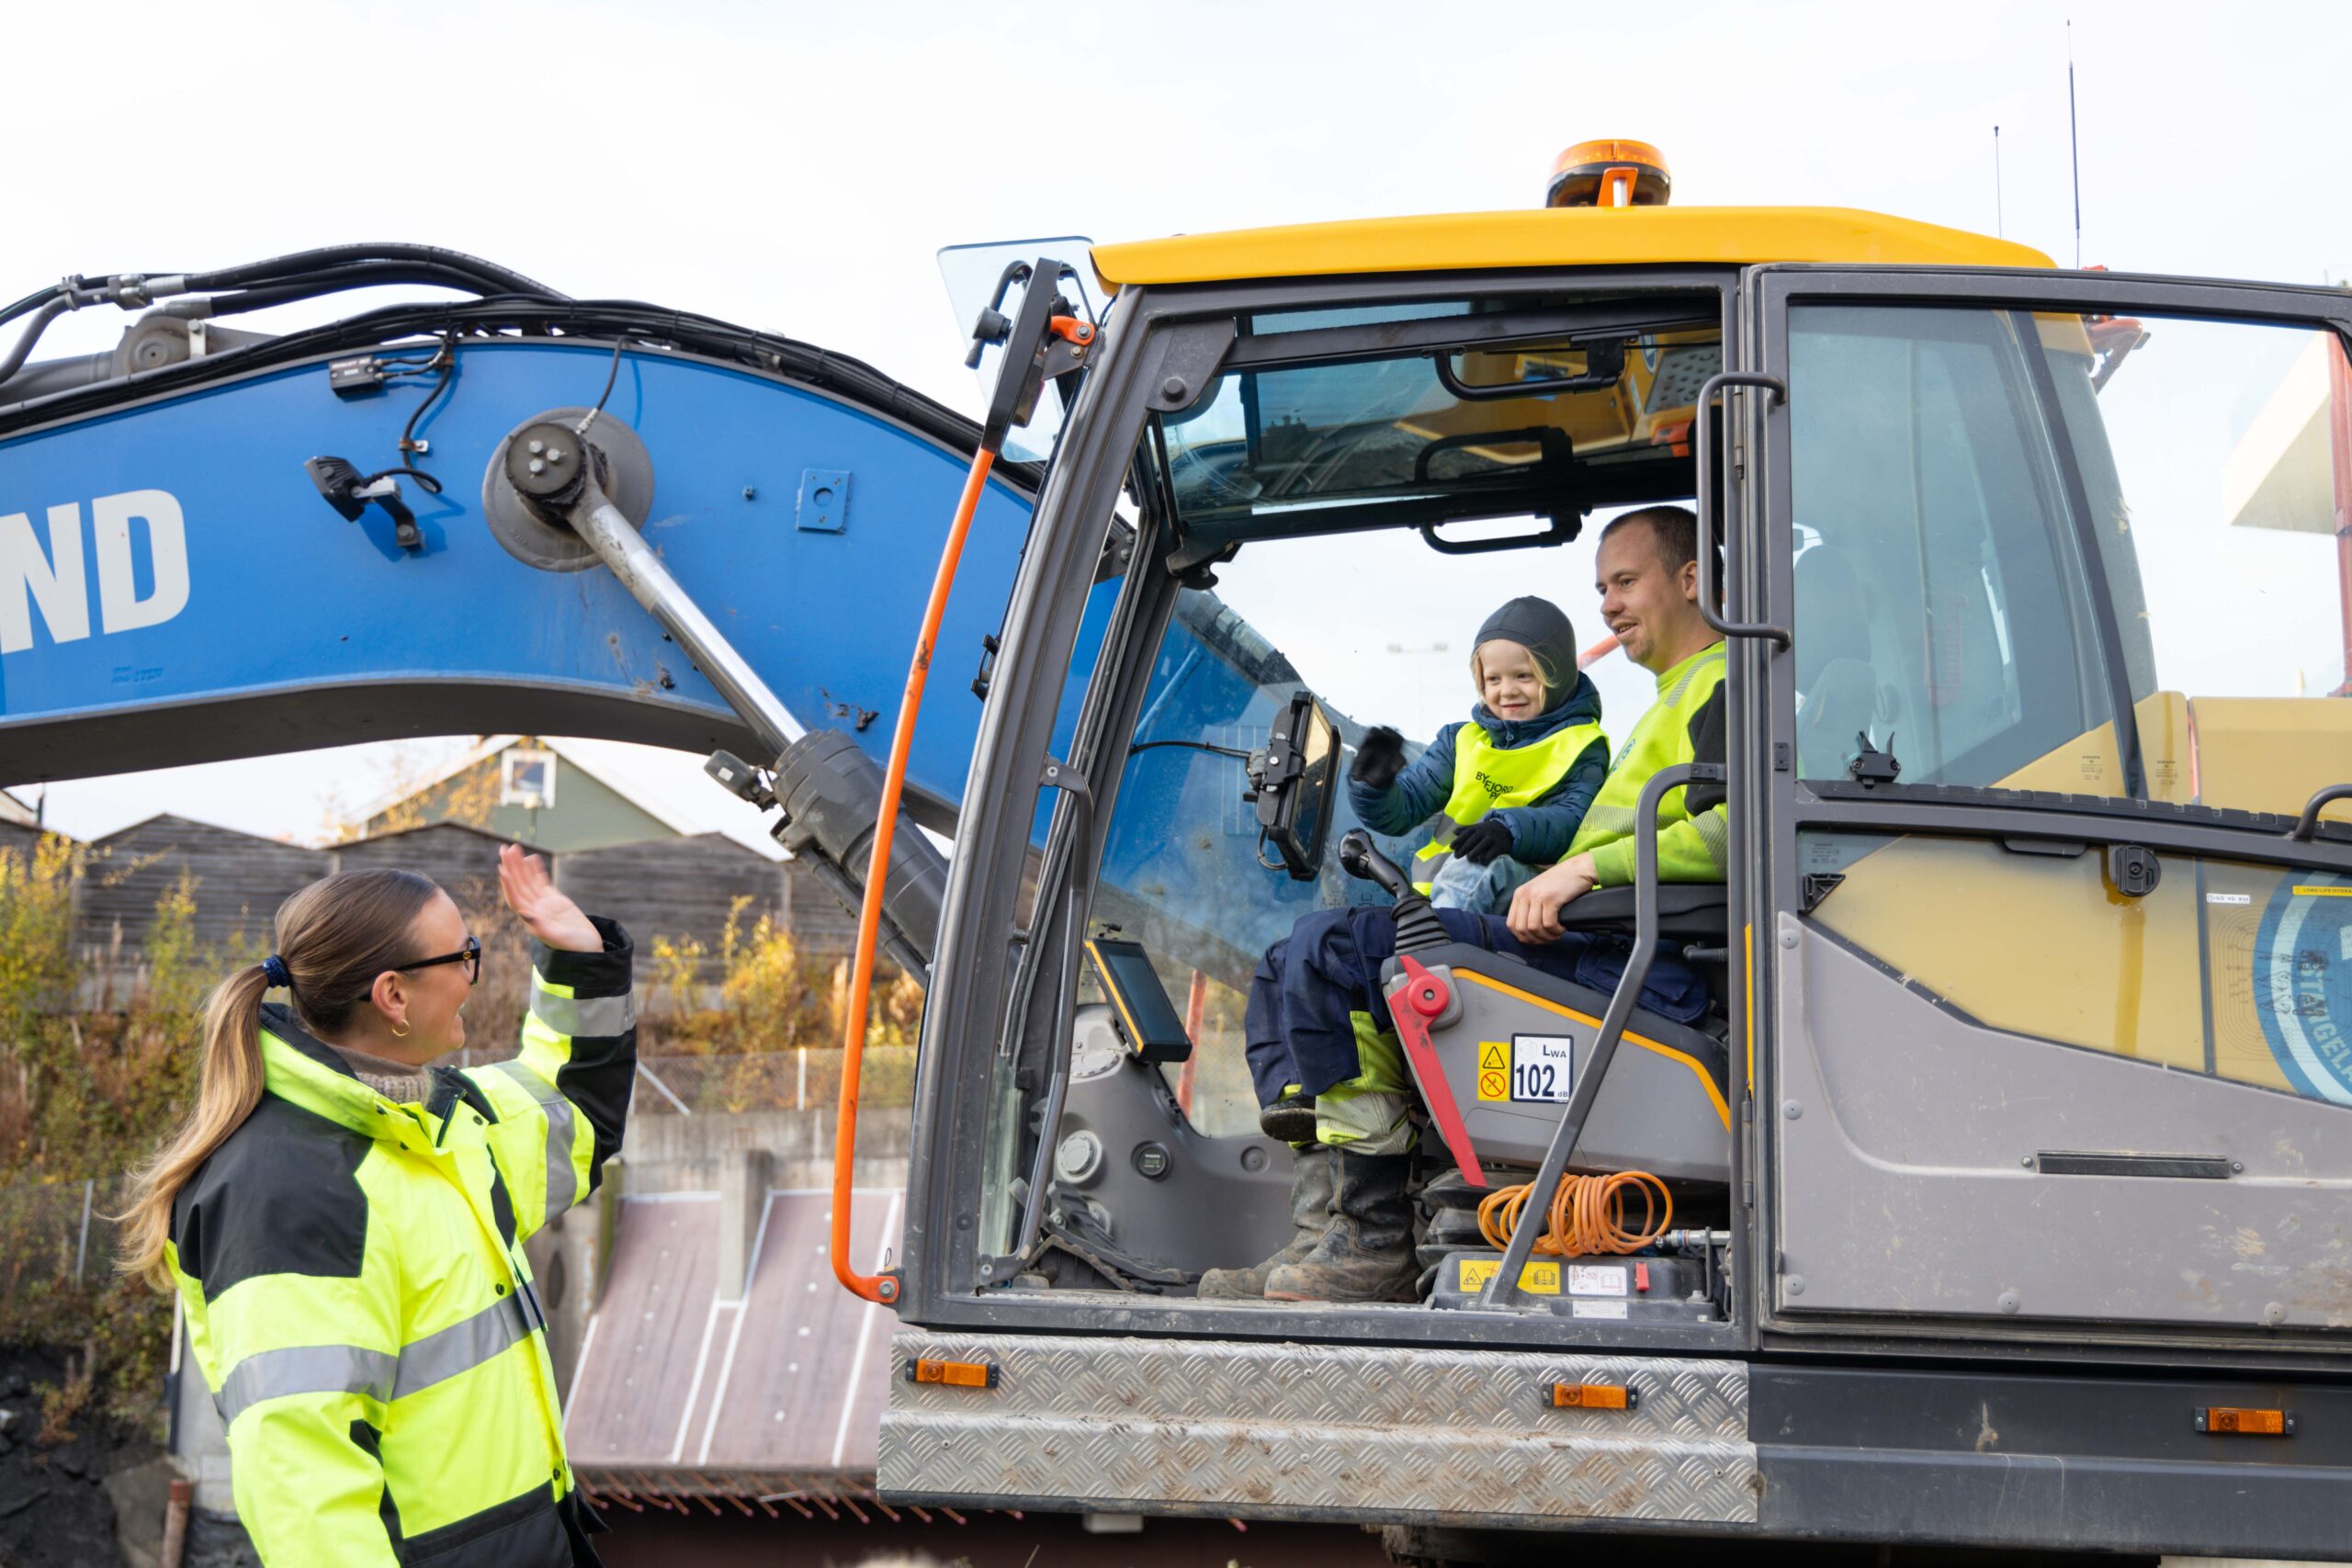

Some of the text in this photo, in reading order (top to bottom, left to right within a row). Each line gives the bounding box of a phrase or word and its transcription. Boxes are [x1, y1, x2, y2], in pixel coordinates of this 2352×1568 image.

[0, 489, 190, 655] ND
[1476, 772, 1490, 784] BY
[1484, 780, 1514, 794] FJORD
[1516, 1064, 1555, 1098] 102
